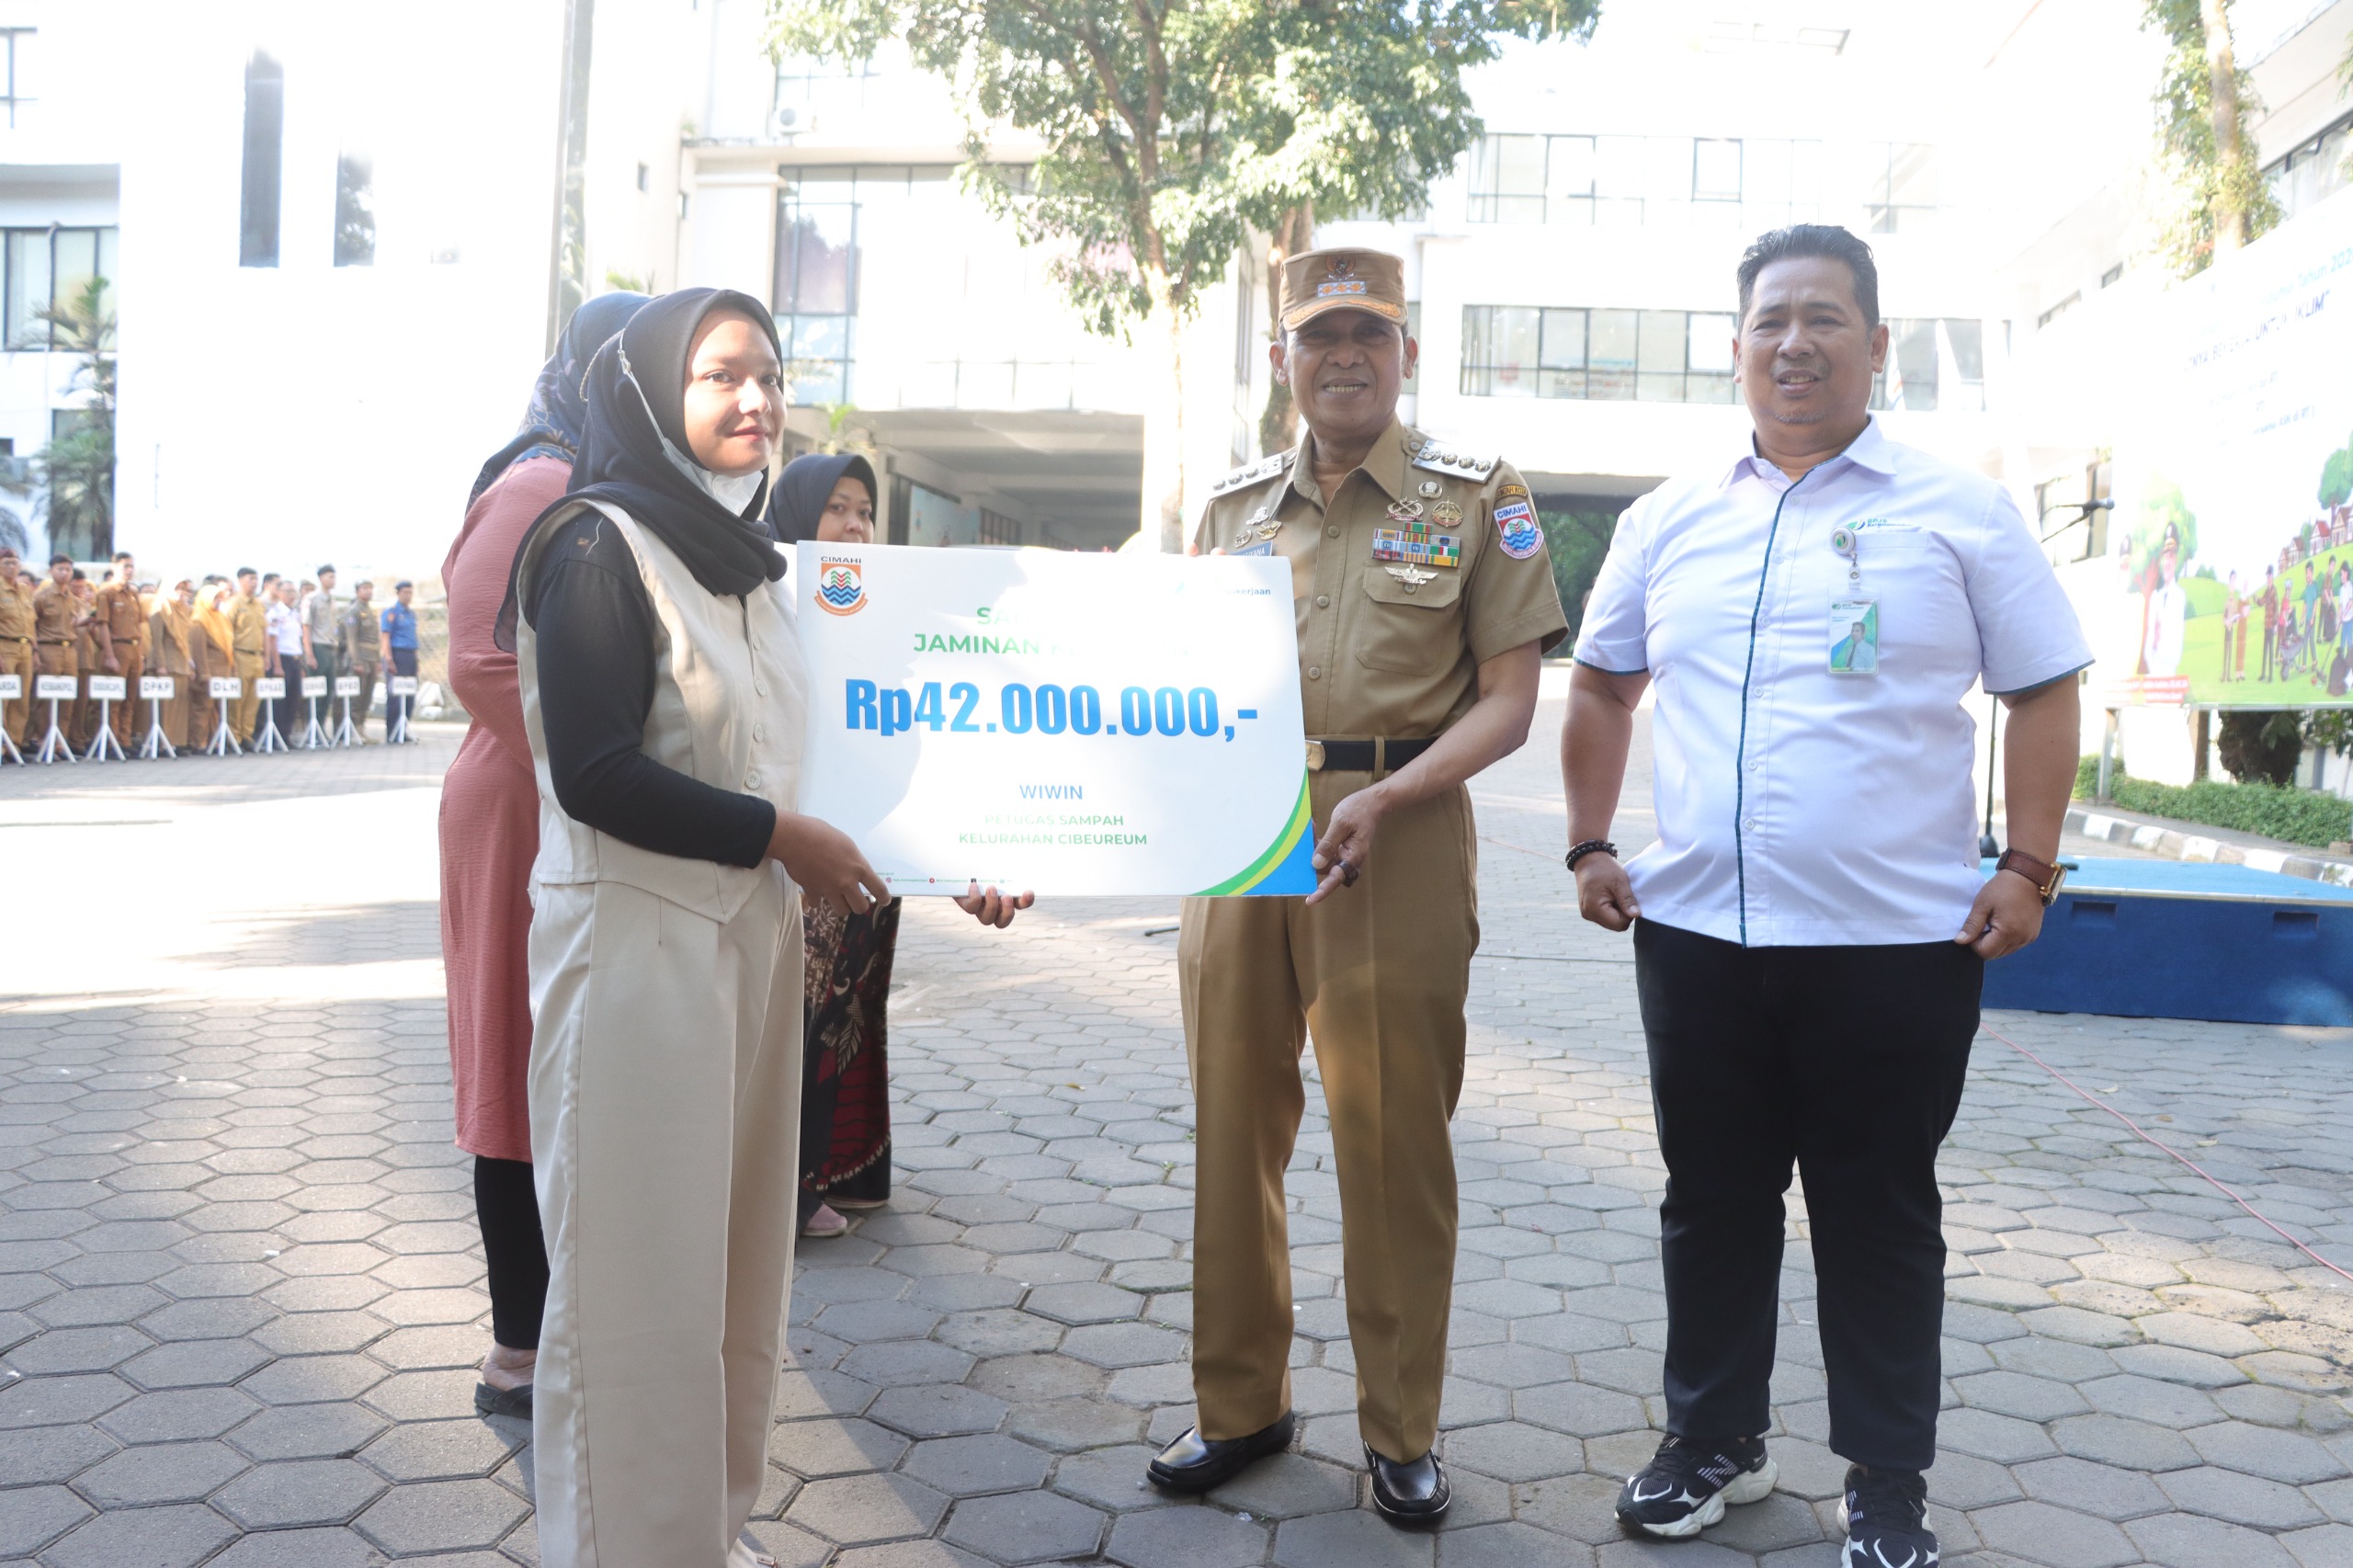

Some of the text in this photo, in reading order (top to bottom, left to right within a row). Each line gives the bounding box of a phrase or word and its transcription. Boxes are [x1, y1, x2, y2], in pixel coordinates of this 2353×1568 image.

[2330, 245, 2353, 273] 202
[1497, 505, 1528, 519] CIMAHI
[821, 556, 862, 564] CIMAHI
[914, 633, 1040, 656] JAMINAN
[143, 682, 171, 691] DPKP
[213, 682, 238, 691] DLH
[846, 679, 1258, 743] Rp42.000.000,-
[1019, 784, 1084, 801] WIWIN
[985, 814, 1125, 825] PETUGAS SAMPAH
[959, 833, 1148, 845] KELURAHAN CIBEUREUM
